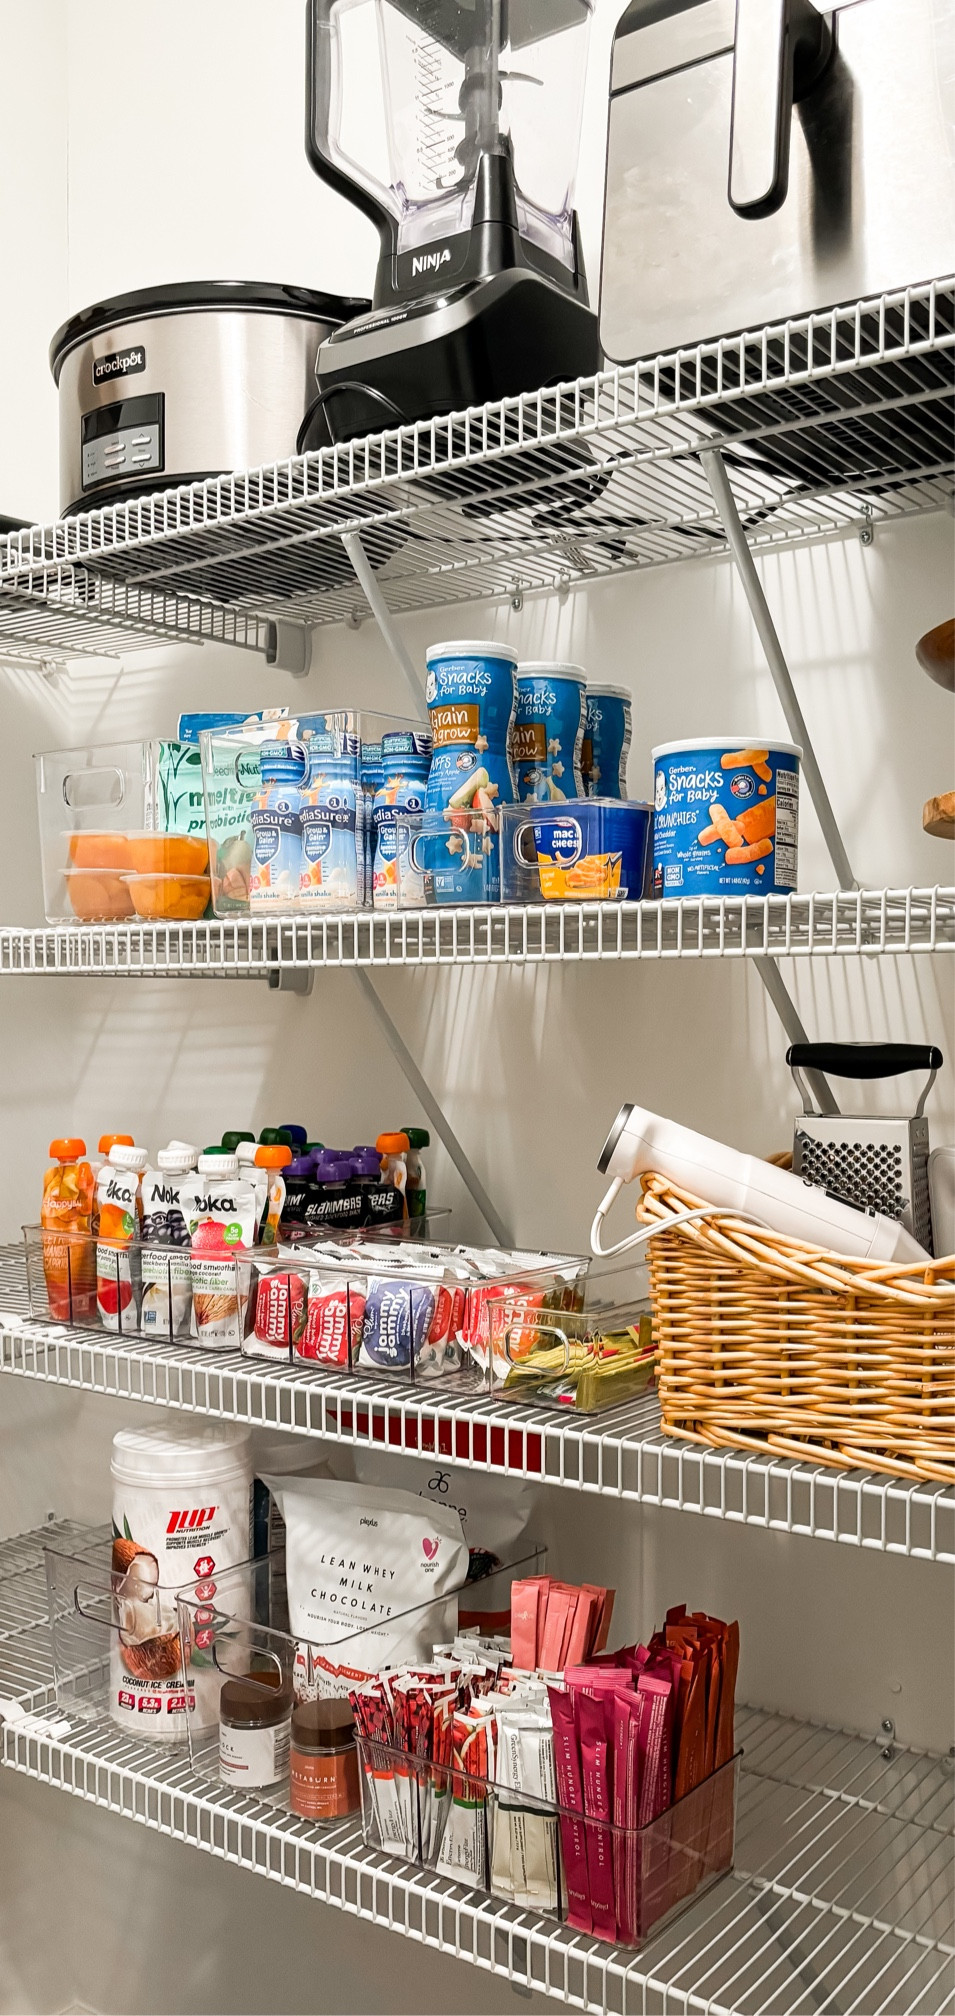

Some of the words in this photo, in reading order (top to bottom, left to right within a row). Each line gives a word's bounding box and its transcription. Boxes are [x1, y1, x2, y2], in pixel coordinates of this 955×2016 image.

[412, 249, 451, 277] NINJA
[440, 671, 492, 686] Snacks
[440, 685, 455, 696] for
[459, 684, 488, 697] Baby
[431, 706, 468, 730] Grain
[525, 705, 553, 716] Baby
[669, 765, 695, 774] Gerber
[669, 770, 724, 791] Snacks
[669, 790, 684, 805] for
[687, 788, 719, 803] Baby
[553, 830, 574, 839] mac
[151, 1184, 180, 1205] Nok
[266, 1279, 280, 1340] sammy
[275, 1282, 290, 1342] jammy
[316, 1299, 339, 1360] sammy
[363, 1305, 375, 1339] Plum
[374, 1291, 396, 1355] jammy
[387, 1287, 409, 1358] sammy
[176, 1525, 210, 1533] NUTRITION
[359, 1517, 378, 1527] plexus
[320, 1554, 356, 1571] LEAN
[363, 1563, 395, 1580] WHEY
[339, 1577, 373, 1593] MILK
[311, 1588, 392, 1616] CHOCOLATE
[307, 1612, 327, 1622] NOURISH
[328, 1618, 340, 1626] YOUR
[122, 1675, 150, 1688] COCONUT
[151, 1681, 162, 1689] ICE
[510, 1734, 520, 1780] GreenSynergy
[567, 1765, 576, 1804] HUNGER
